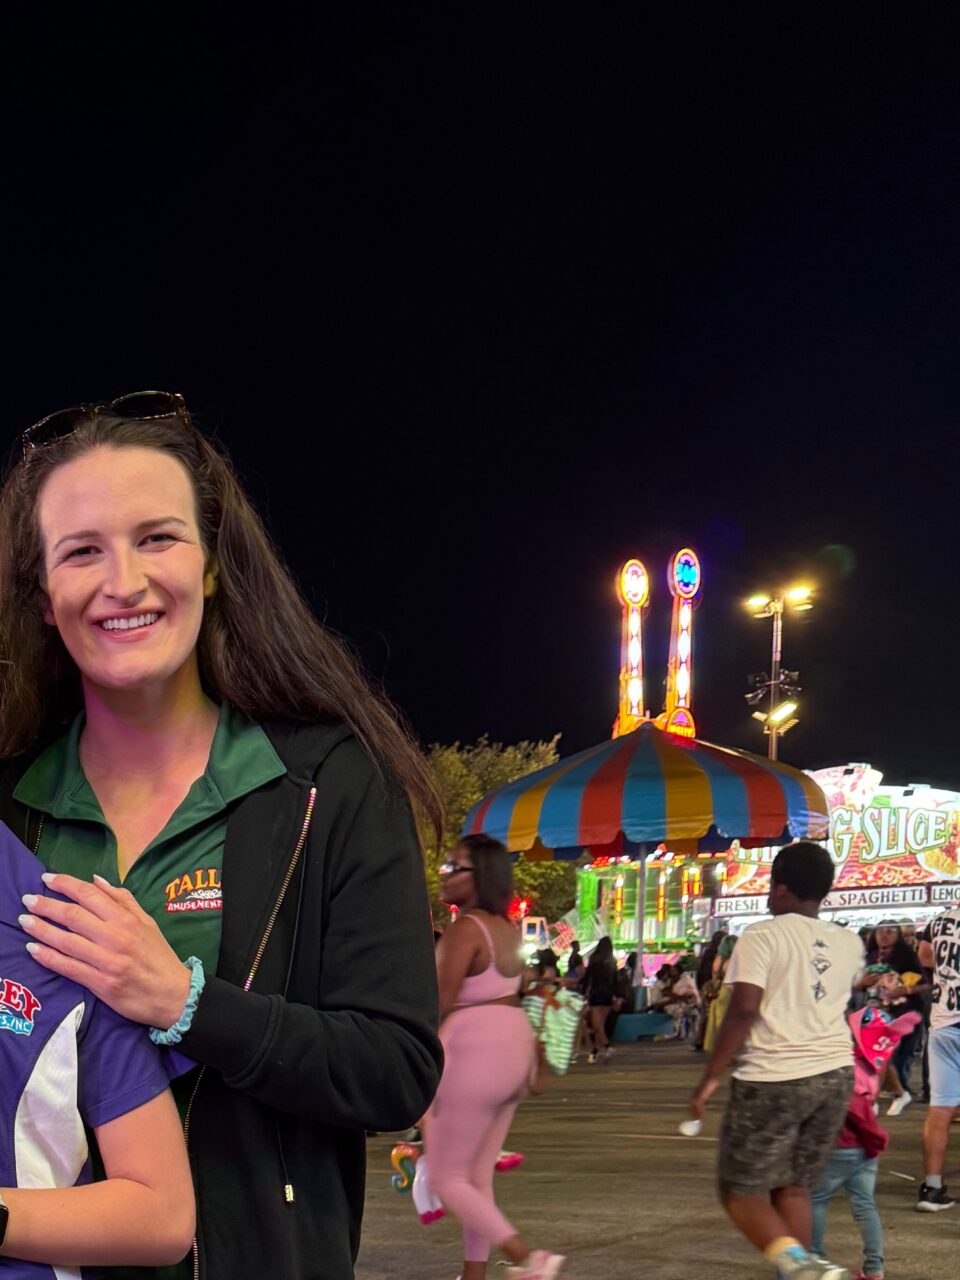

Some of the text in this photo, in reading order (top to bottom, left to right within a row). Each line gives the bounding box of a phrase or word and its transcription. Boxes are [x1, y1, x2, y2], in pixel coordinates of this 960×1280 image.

[859, 806, 949, 863] SLICE
[165, 868, 222, 902] TALL
[167, 899, 223, 911] AMUSEMENT
[717, 899, 759, 912] FRESH
[839, 888, 924, 906] SPAGHETTI
